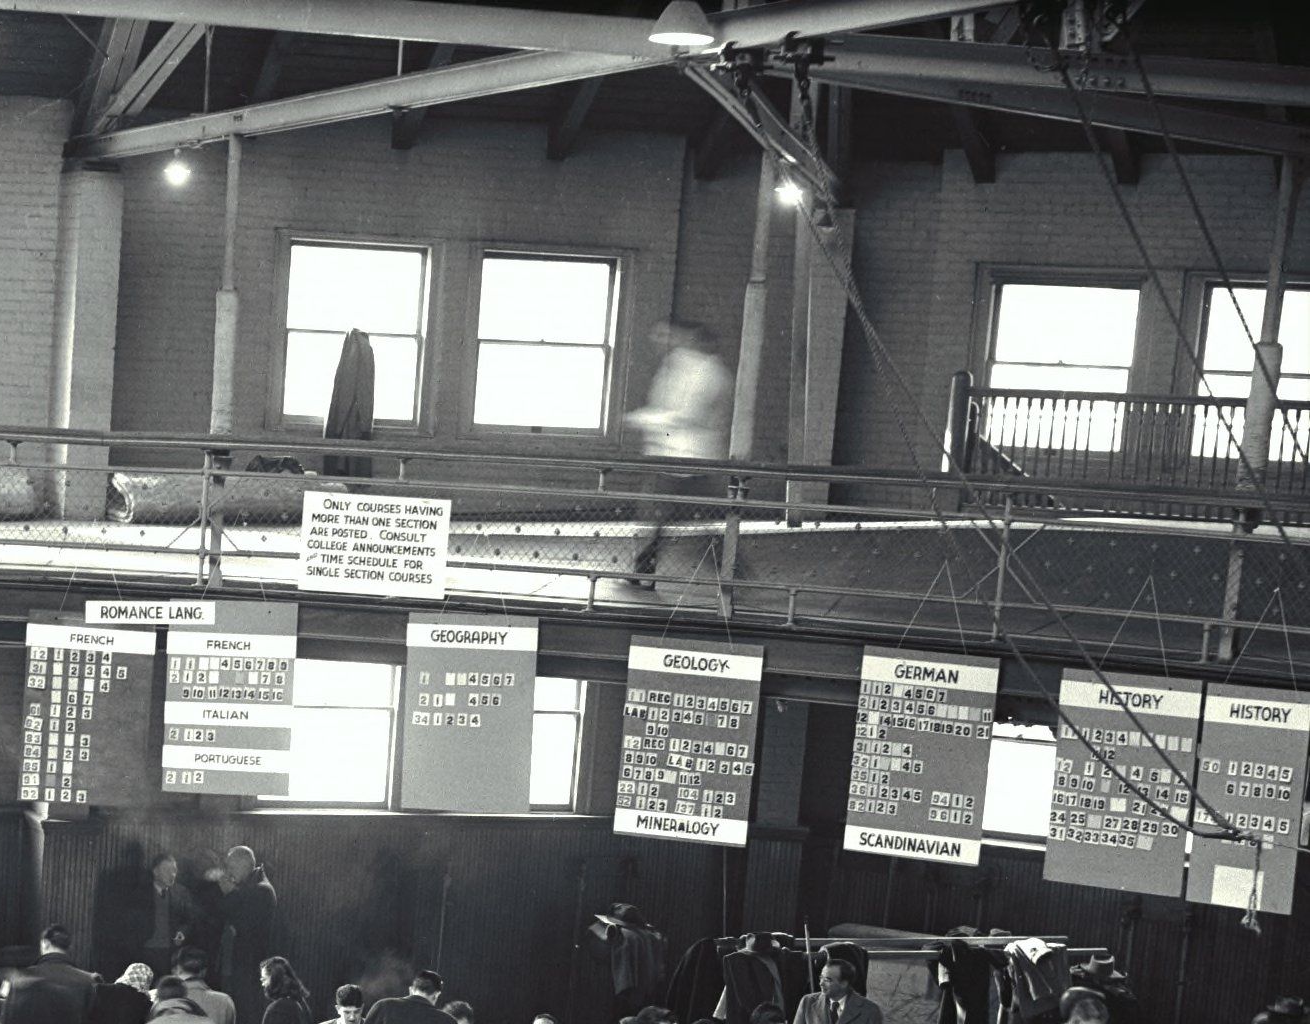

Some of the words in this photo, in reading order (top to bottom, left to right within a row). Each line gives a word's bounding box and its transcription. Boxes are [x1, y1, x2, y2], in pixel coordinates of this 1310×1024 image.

[323, 499, 351, 510] ONLY
[357, 503, 401, 513] COURSES
[405, 505, 443, 516] HAVING
[312, 513, 340, 523] MORE
[344, 516, 369, 525] THAN
[372, 517, 391, 527] ONE
[395, 519, 437, 530] SECTION
[310, 527, 328, 536] ARE
[379, 530, 427, 542] CONSULT
[307, 540, 347, 551] COLLEGE
[352, 543, 435, 557] ANNOUNCEMENTS
[321, 554, 344, 564] TIME
[348, 556, 397, 568] SCHEDULE
[404, 560, 423, 570] FOR
[306, 566, 339, 577] SINGLE
[344, 569, 384, 580] SECTION
[389, 572, 432, 584] COURSES
[100, 606, 163, 619] ROMANCE
[169, 607, 204, 620] LANG.
[70, 634, 114, 645] FRENCH
[207, 640, 251, 650] FRENCH
[431, 630, 508, 645] GEOGRAPHY
[664, 654, 730, 673] GEOLOGY
[895, 664, 959, 684] GERMAN
[1099, 690, 1163, 709] HISTORY
[202, 709, 248, 720] ITALIAN
[1230, 704, 1291, 723] HISTORY
[195, 754, 262, 765] PORTUGUESE
[636, 815, 719, 836] MINERALOGY
[860, 832, 961, 857] SCANDINAVIAN
